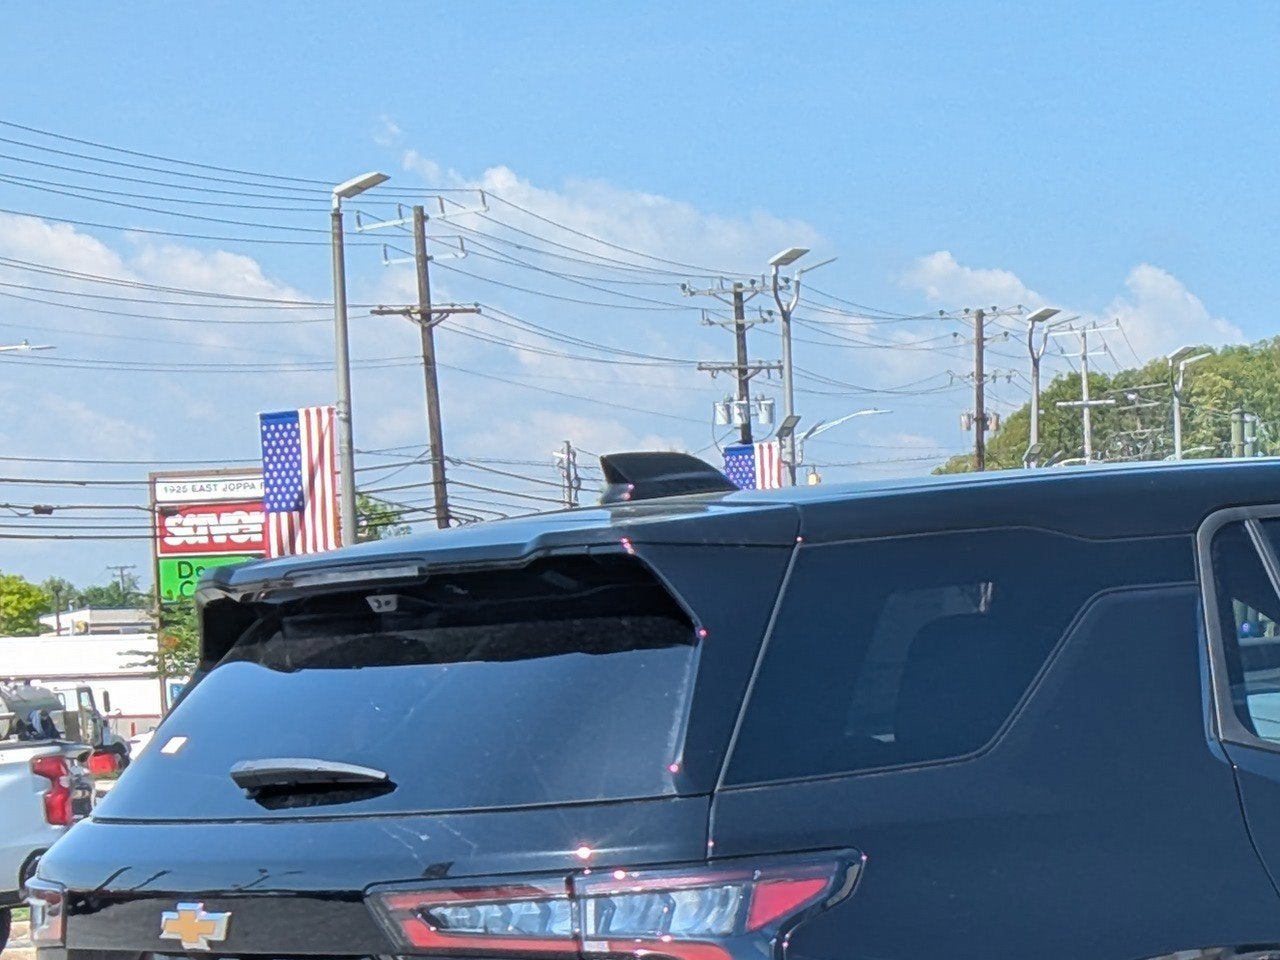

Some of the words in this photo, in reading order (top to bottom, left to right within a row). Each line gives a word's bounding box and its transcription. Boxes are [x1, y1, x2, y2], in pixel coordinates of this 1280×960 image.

[191, 483, 218, 493] EAST
[222, 482, 256, 492] JOPPA
[163, 510, 265, 546] saver
